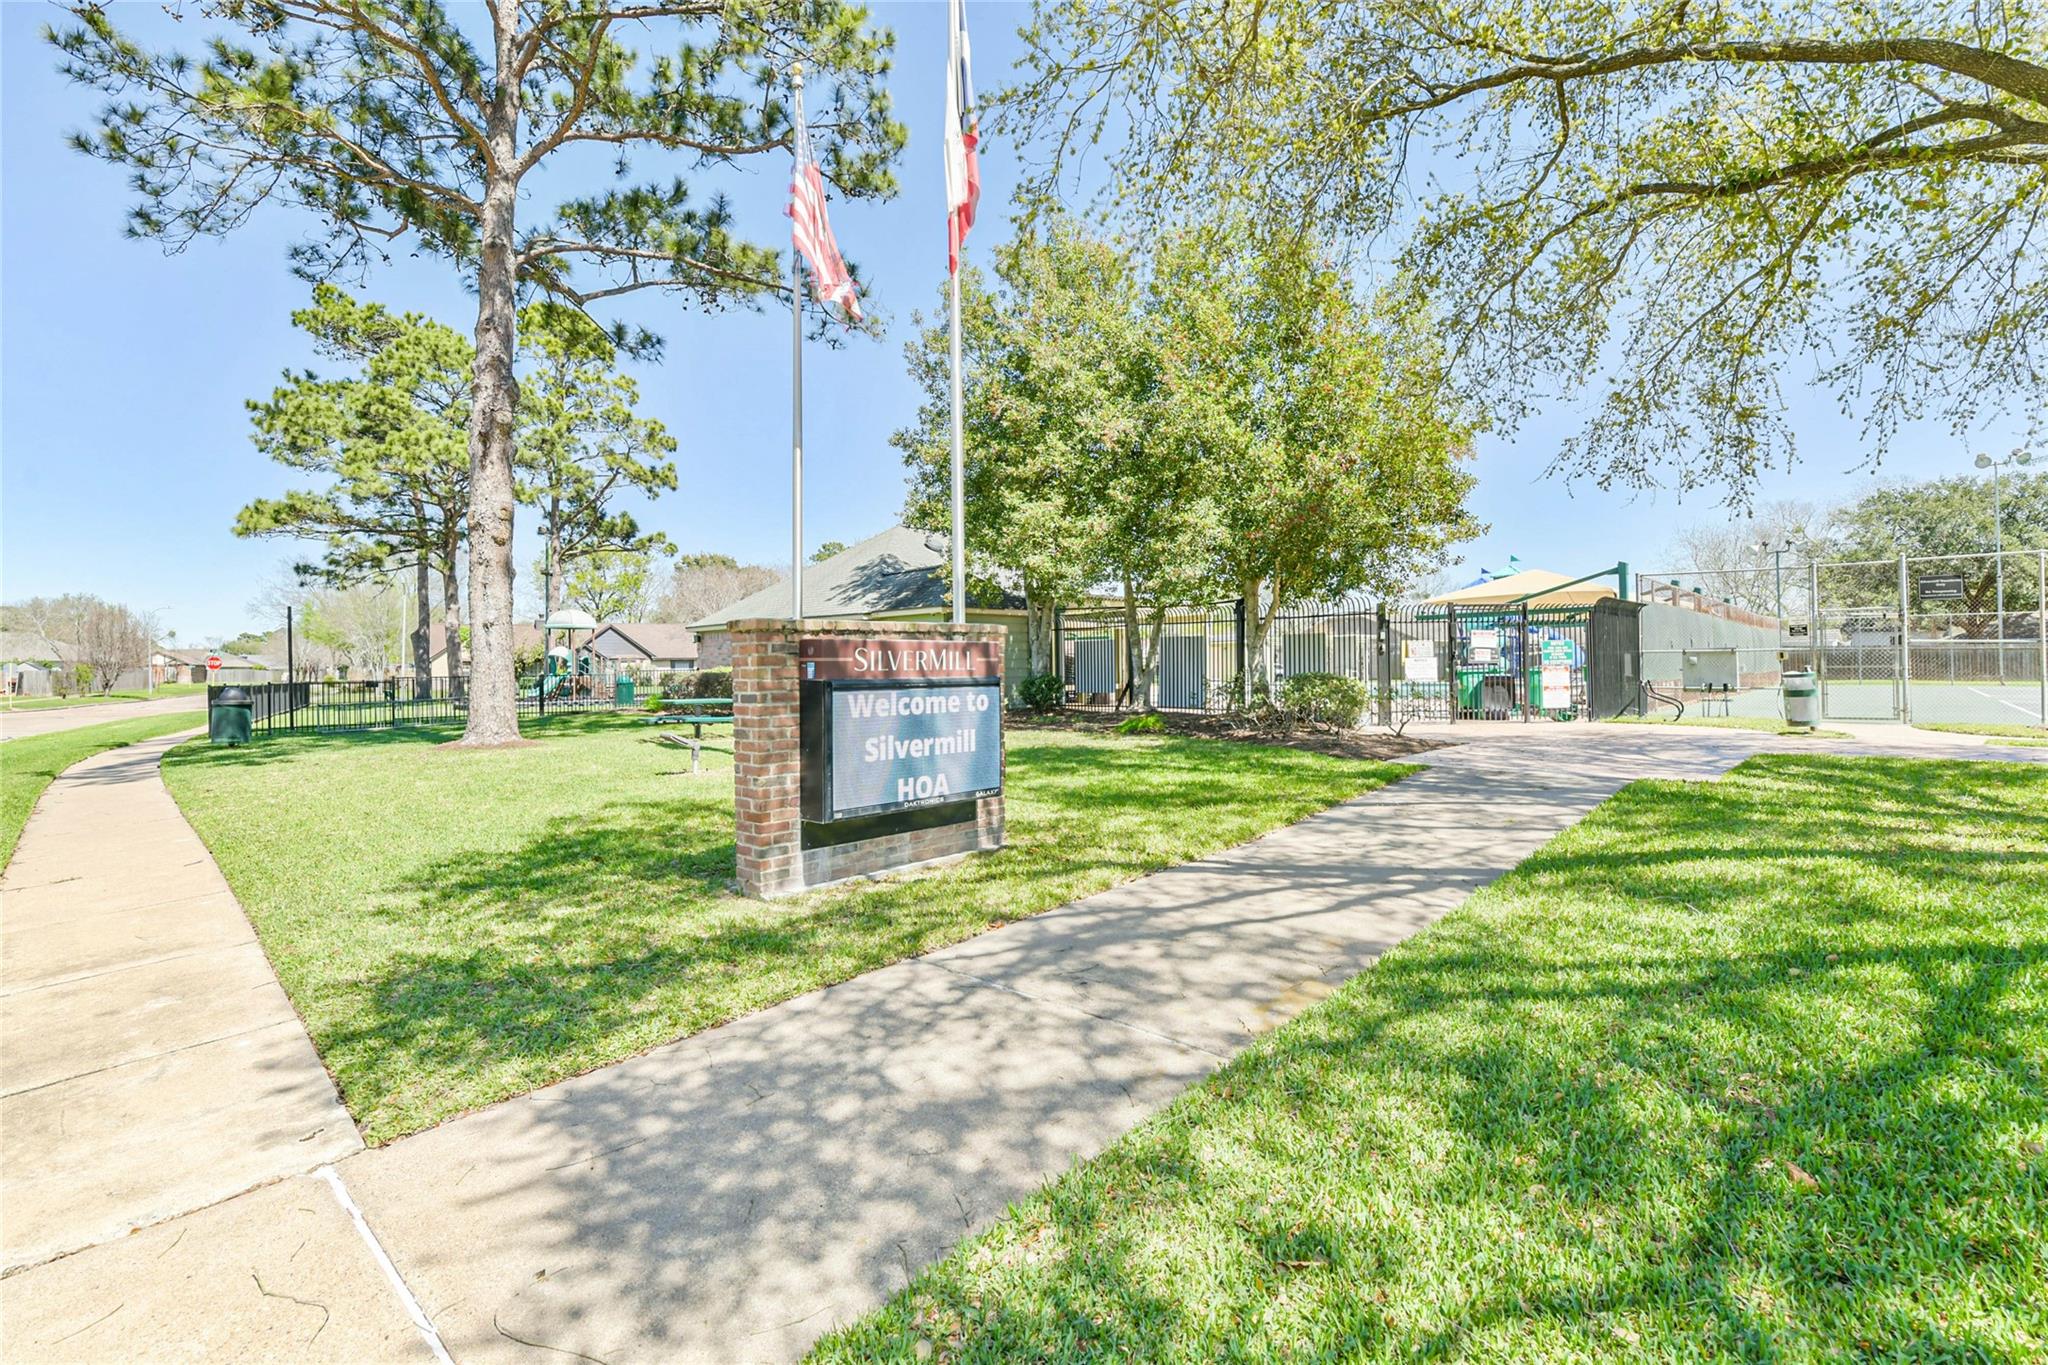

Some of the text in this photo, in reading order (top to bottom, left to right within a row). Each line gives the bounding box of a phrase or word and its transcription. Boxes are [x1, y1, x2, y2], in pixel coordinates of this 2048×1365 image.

[854, 647, 976, 672] SILVERMILL
[848, 691, 989, 718] Welcome to
[865, 729, 976, 762] Silvermill
[897, 772, 950, 801] HOA
[975, 789, 998, 798] GALAXY
[904, 797, 945, 808] DAKTRONICS
